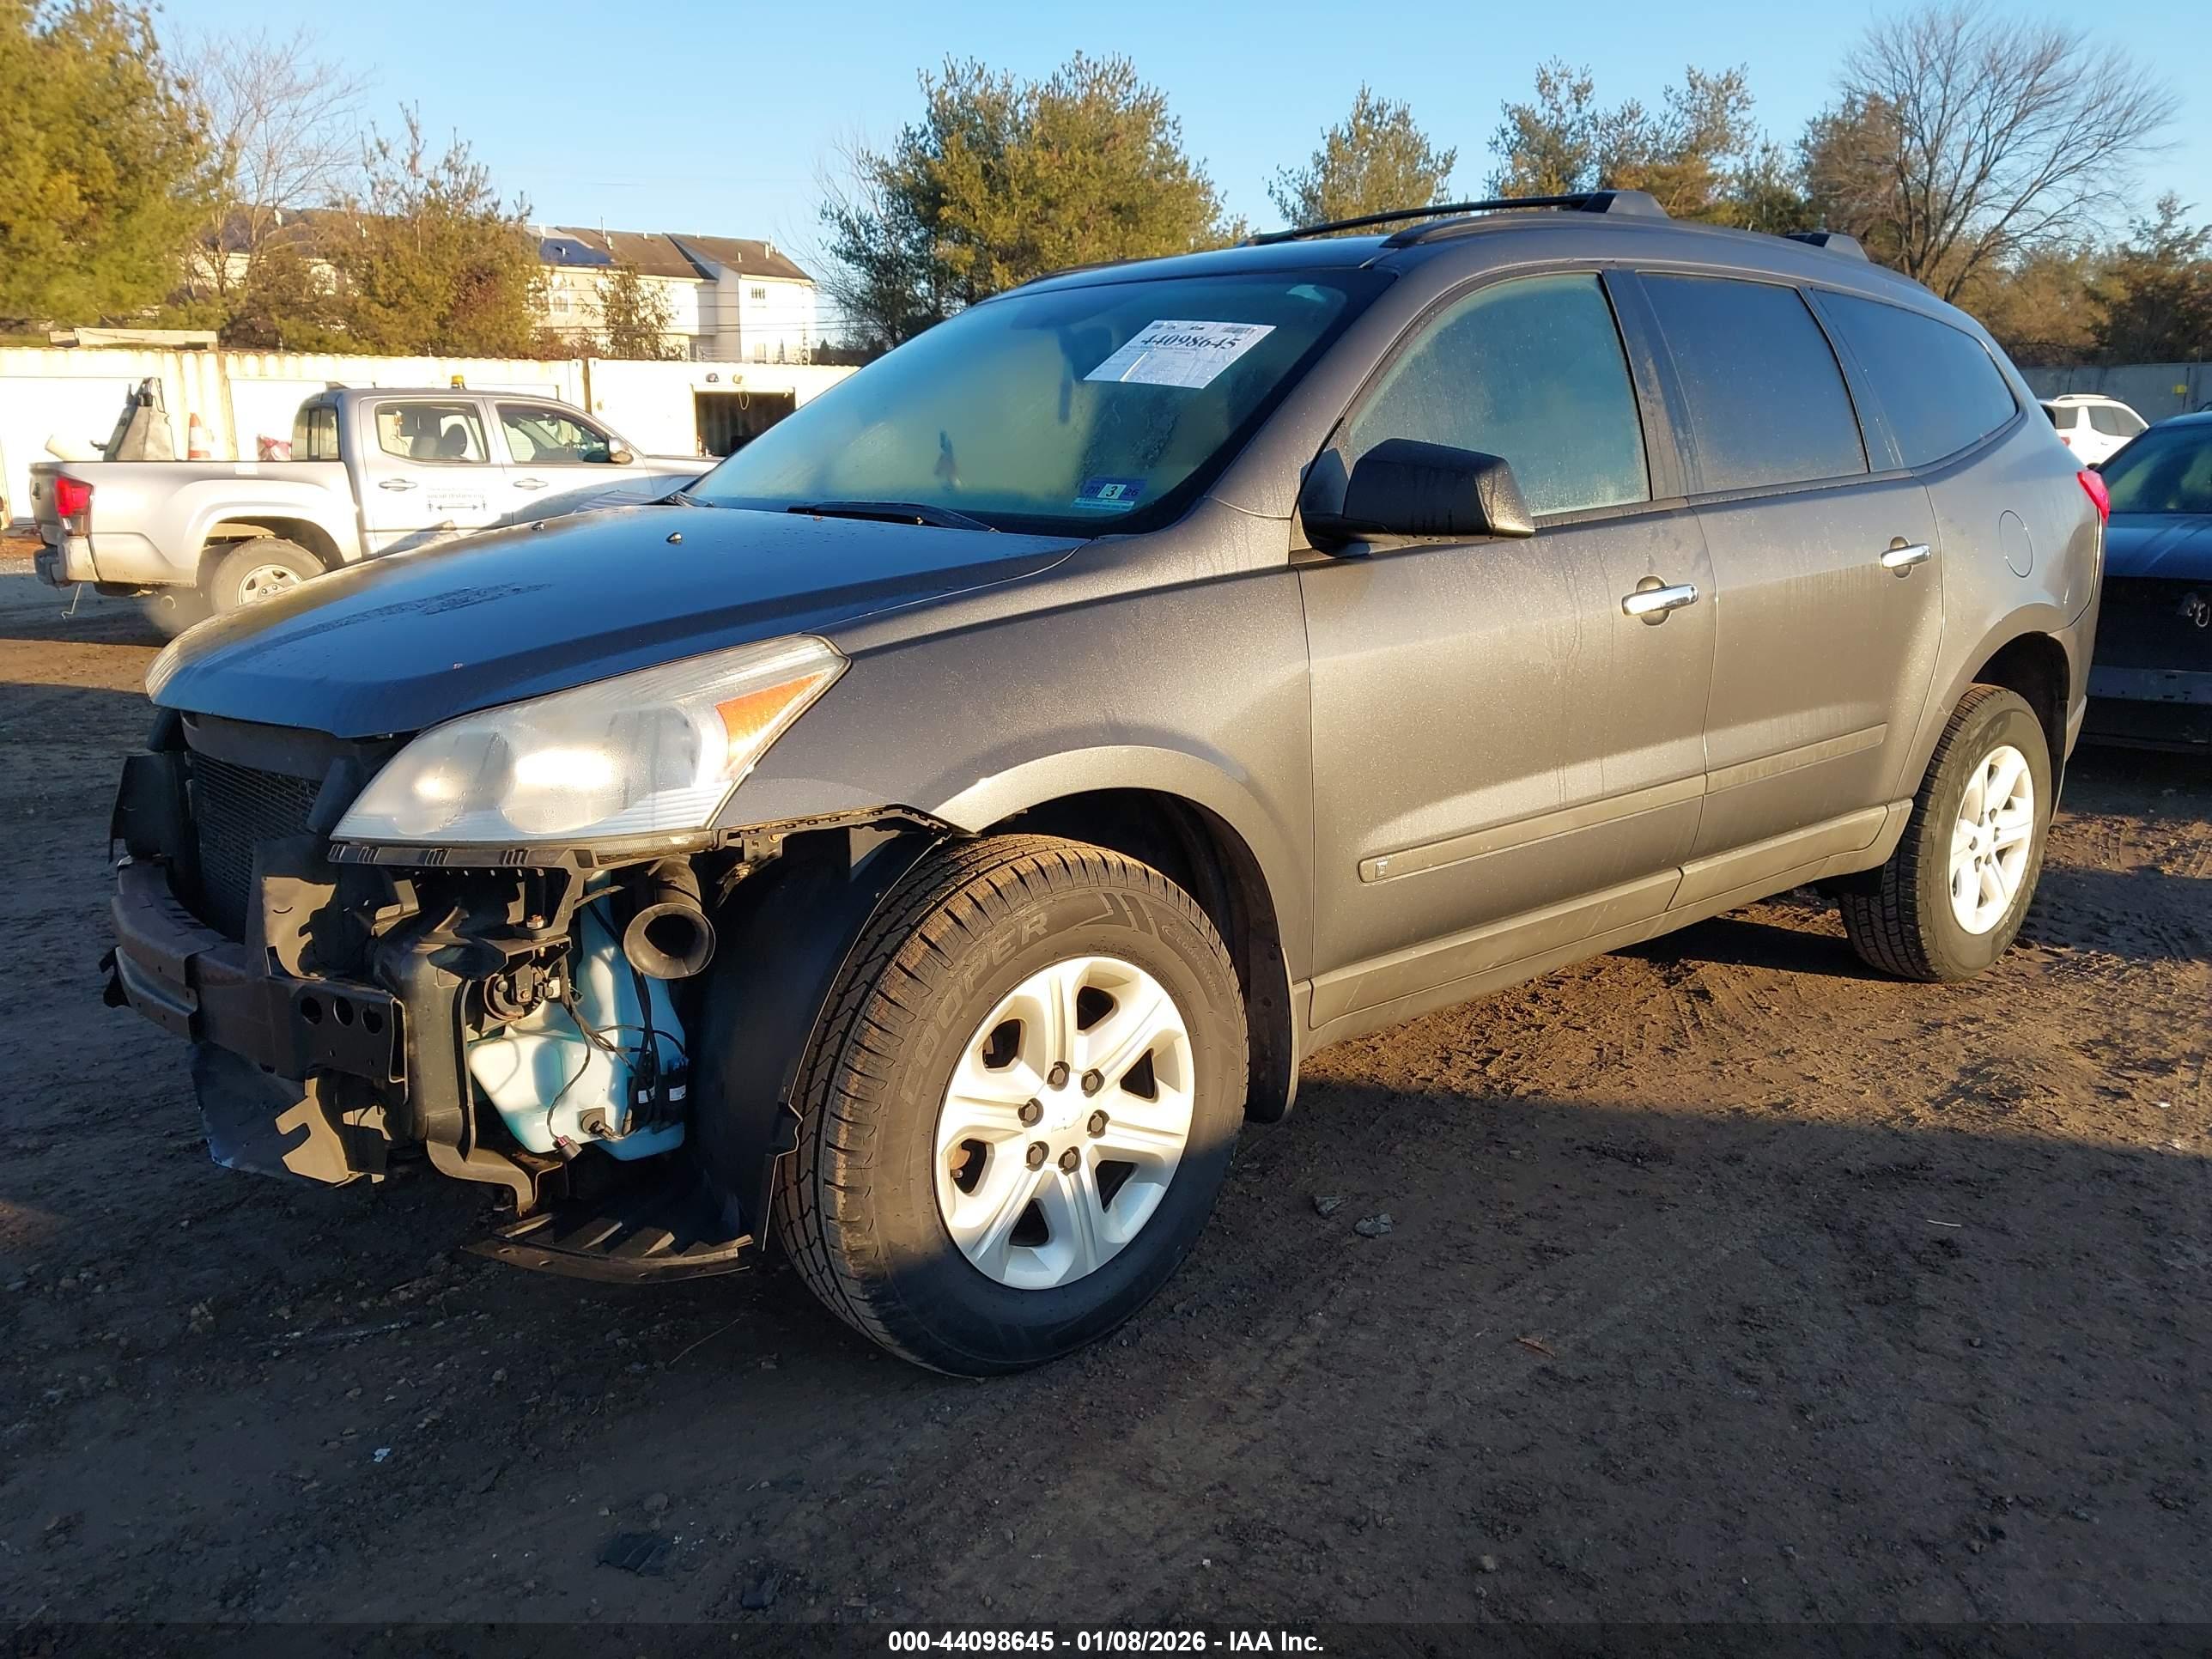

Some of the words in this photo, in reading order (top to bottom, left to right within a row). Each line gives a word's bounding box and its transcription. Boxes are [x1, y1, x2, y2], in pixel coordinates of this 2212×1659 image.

[1140, 332, 1240, 350] 44098645
[1105, 485, 1118, 497] 3
[899, 911, 1048, 1106] COOPER
